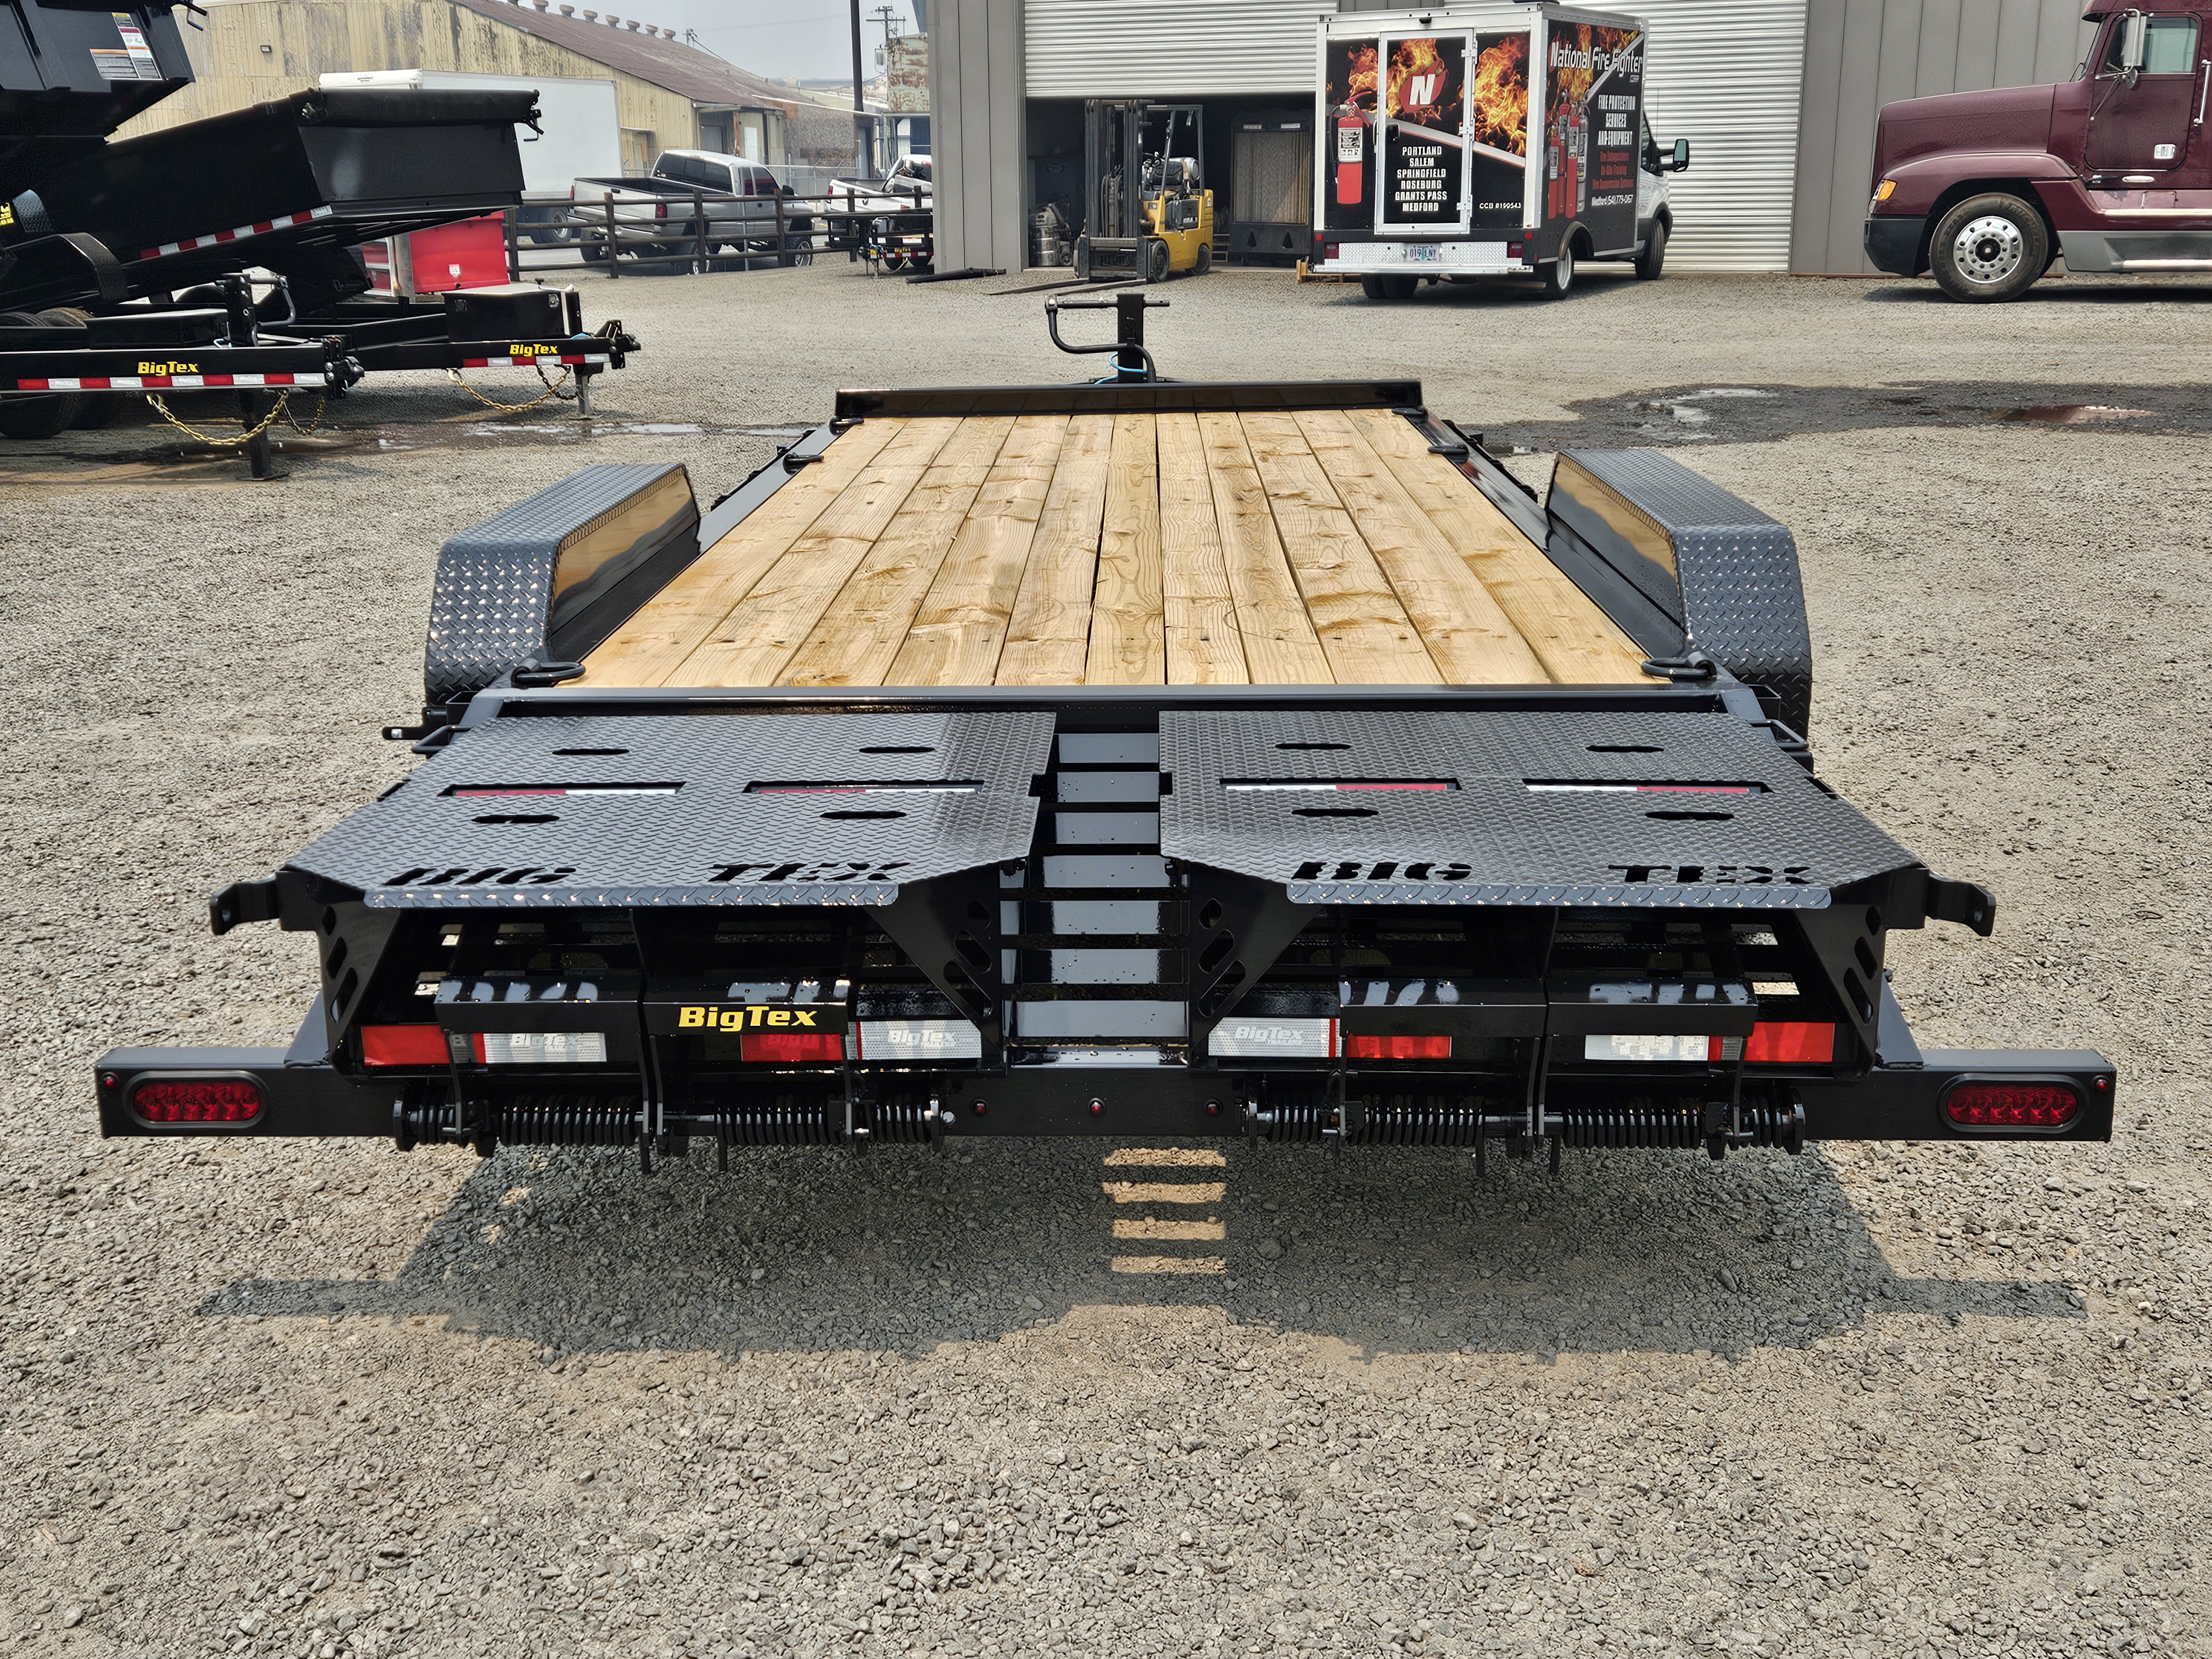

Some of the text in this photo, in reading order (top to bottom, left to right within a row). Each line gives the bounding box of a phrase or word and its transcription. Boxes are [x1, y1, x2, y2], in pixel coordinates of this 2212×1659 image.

[1550, 41, 1643, 78] National Fire Fighter
[1410, 74, 1435, 105] N
[1402, 146, 1442, 156] PORTLAND
[1409, 158, 1434, 166] SALEM
[1397, 169, 1446, 178] SPRINGFIELD
[1401, 180, 1442, 189] ROSEBURG
[1395, 191, 1447, 200] GRANTS PASS
[1402, 202, 1439, 211] MEDFORD
[509, 344, 558, 357] BigTex
[138, 361, 200, 376] BigTex
[382, 863, 910, 885] BIG TEX
[1291, 862, 1812, 884] BIG TEX
[679, 1006, 818, 1032] BigTex
